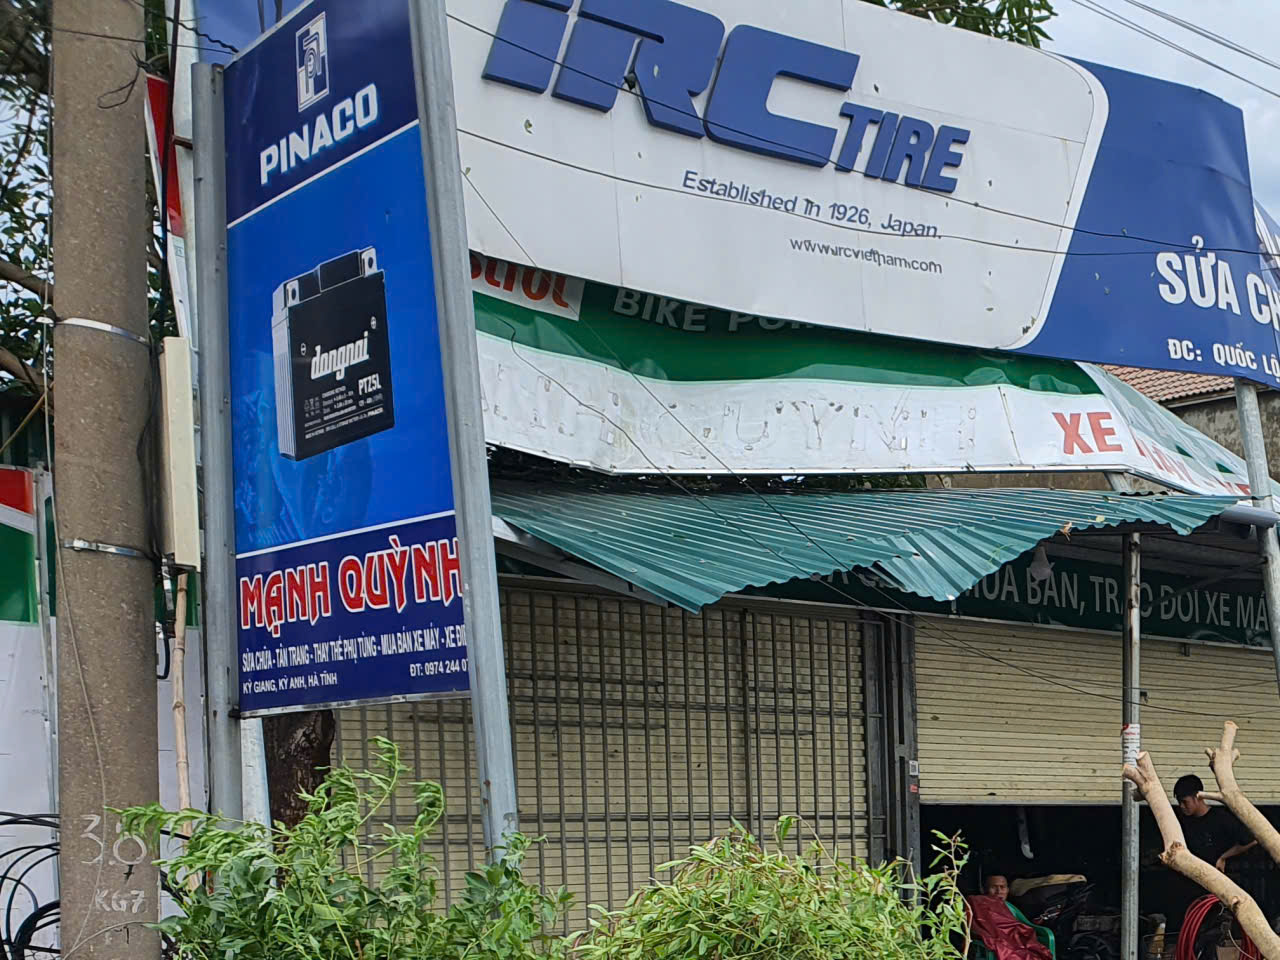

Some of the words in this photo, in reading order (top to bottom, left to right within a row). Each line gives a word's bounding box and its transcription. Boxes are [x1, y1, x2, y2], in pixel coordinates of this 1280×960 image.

[481, 0, 861, 168] IRC
[260, 83, 379, 186] PINACO
[834, 101, 971, 193] TIRE
[682, 169, 799, 214] Established
[829, 201, 873, 229] 1926,
[880, 213, 943, 240] Japan.
[1156, 235, 1241, 315] SỬA
[612, 287, 708, 333] BIKE
[1167, 338, 1203, 362] ĐC:
[1212, 341, 1258, 371] QUỐC
[1051, 411, 1124, 456] XE
[240, 561, 332, 638] MẠNH
[338, 535, 465, 614] QUỲNH
[1090, 575, 1154, 618] TRO
[1205, 590, 1231, 627] XE
[313, 641, 330, 664] THAY
[380, 632, 398, 656] MUA
[412, 629, 425, 652] XE
[444, 625, 457, 649] XE
[424, 660, 445, 676] 0974
[444, 658, 461, 674] 244
